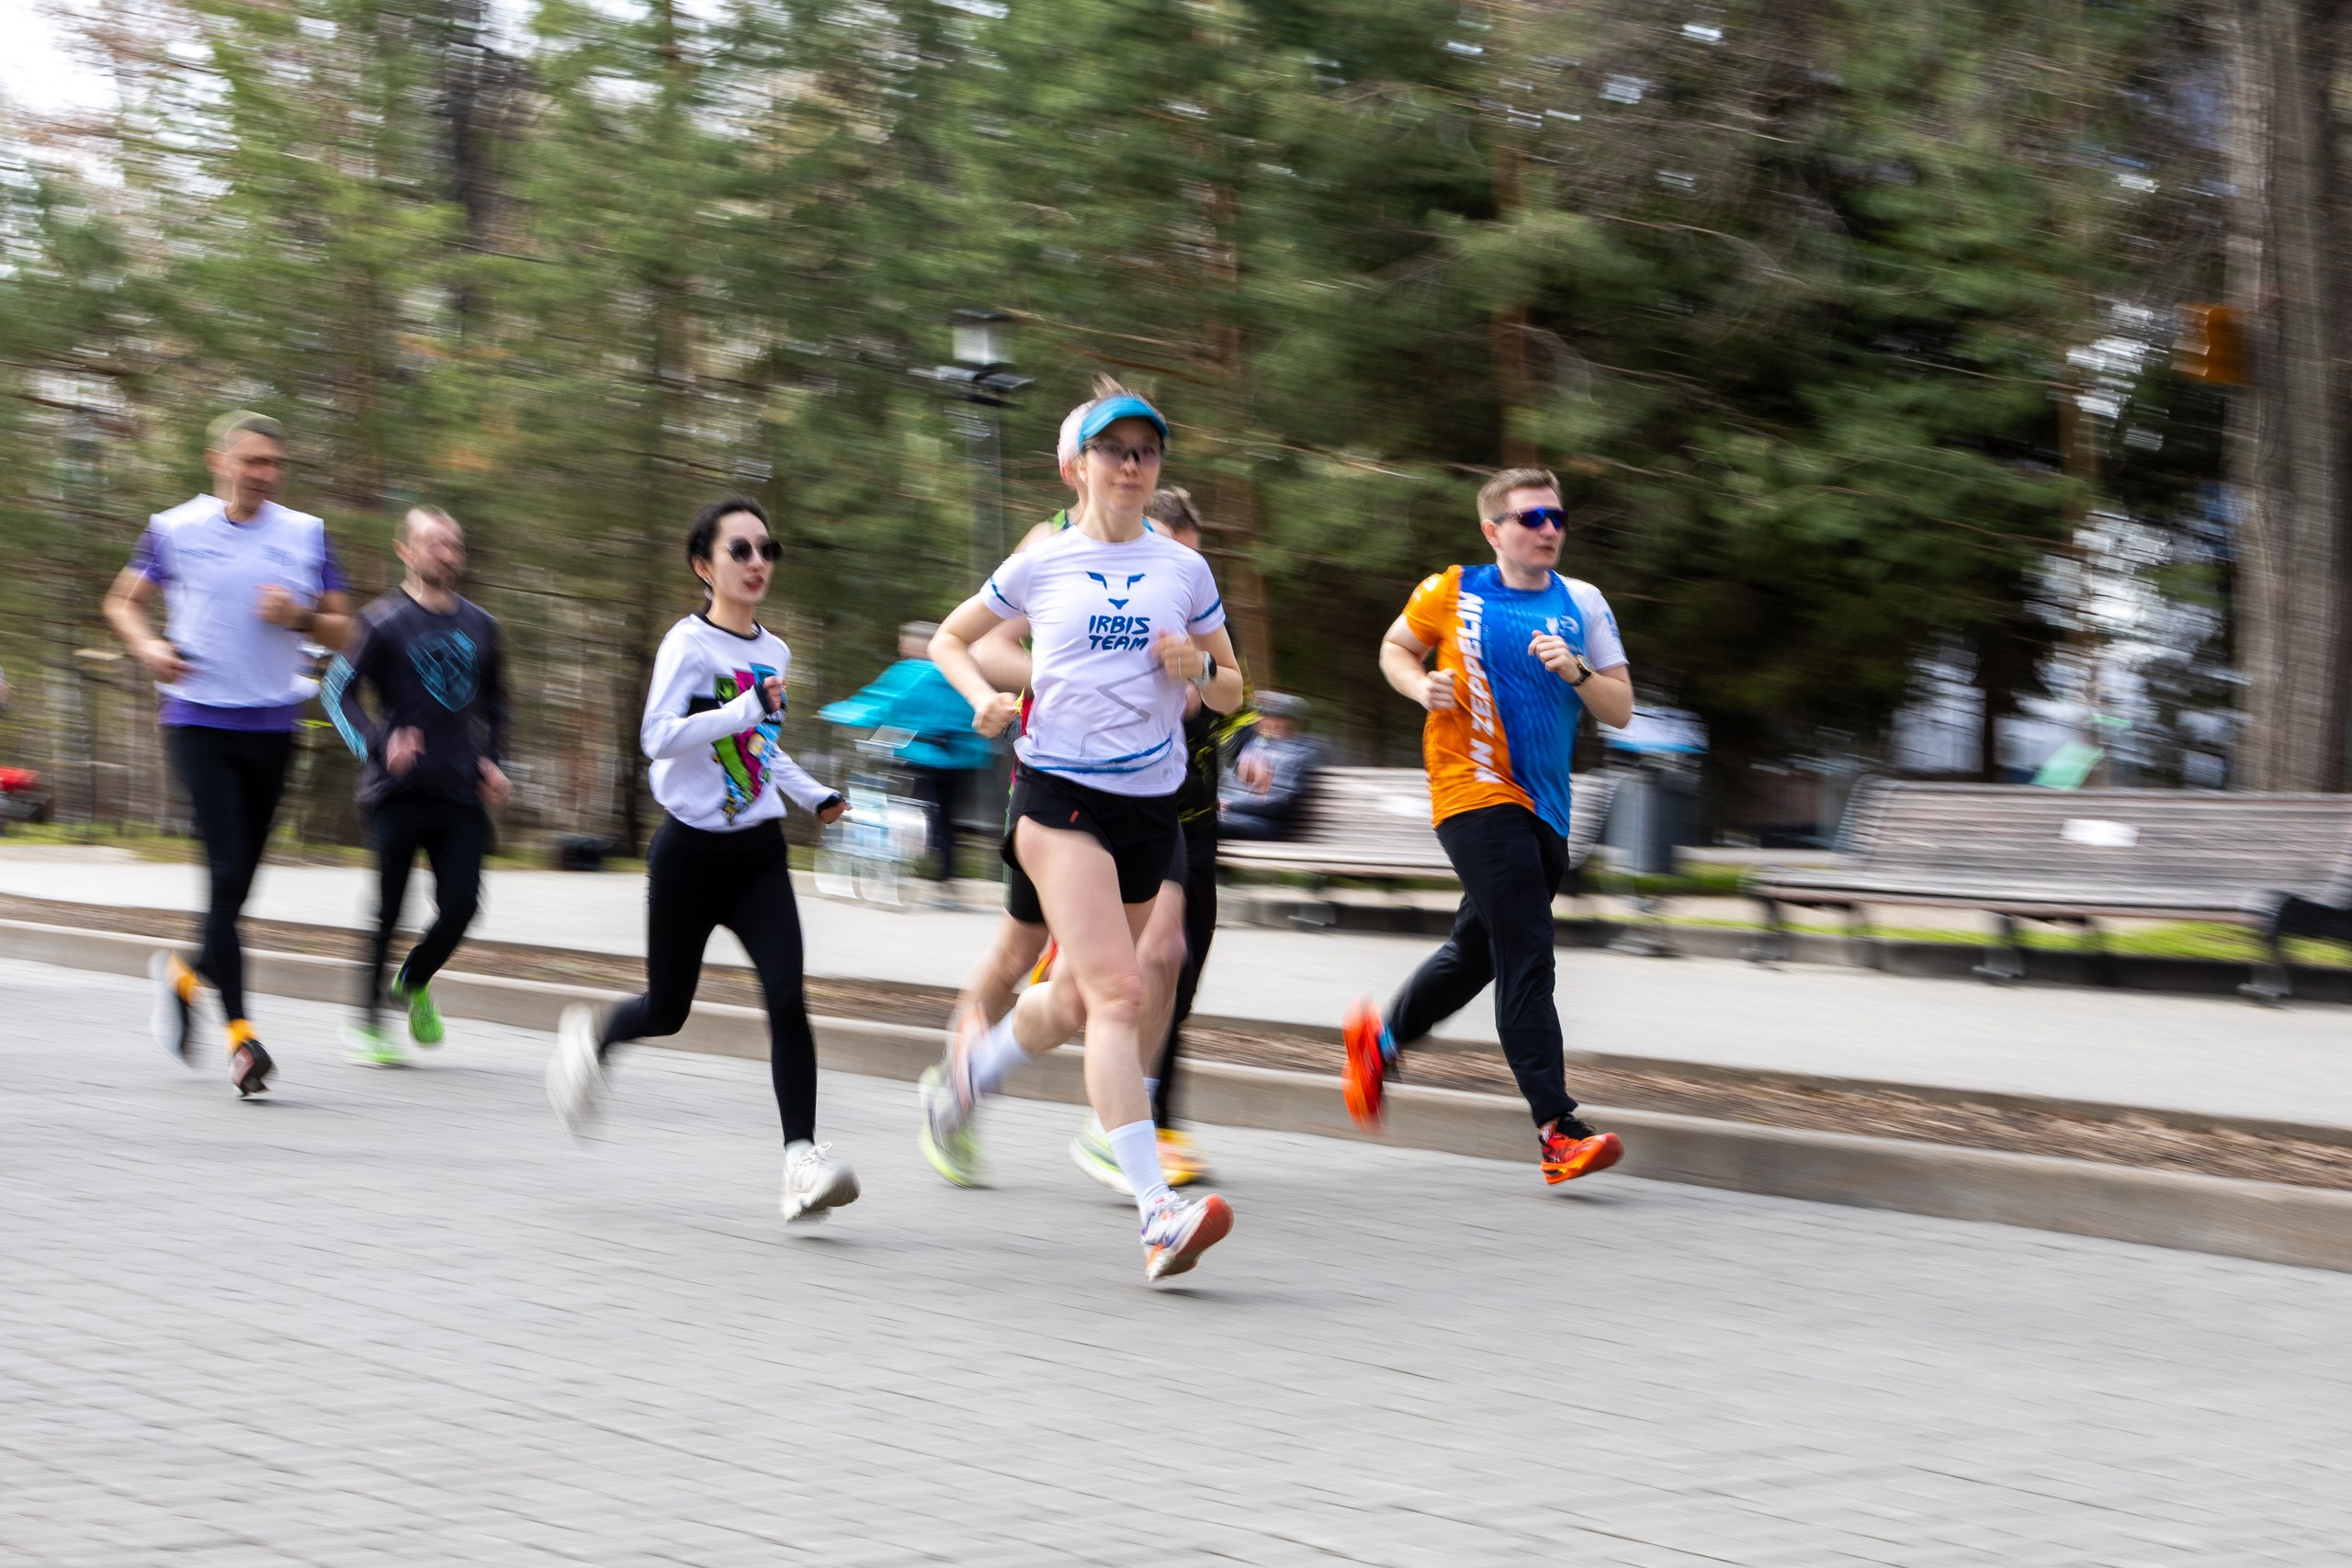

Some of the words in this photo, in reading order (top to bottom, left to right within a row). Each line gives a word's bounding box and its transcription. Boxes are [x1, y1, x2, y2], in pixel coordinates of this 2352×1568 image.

[1089, 615, 1150, 635] IRBIS
[1088, 634, 1149, 651] TEAM
[1455, 590, 1495, 739] ZEPPELIN
